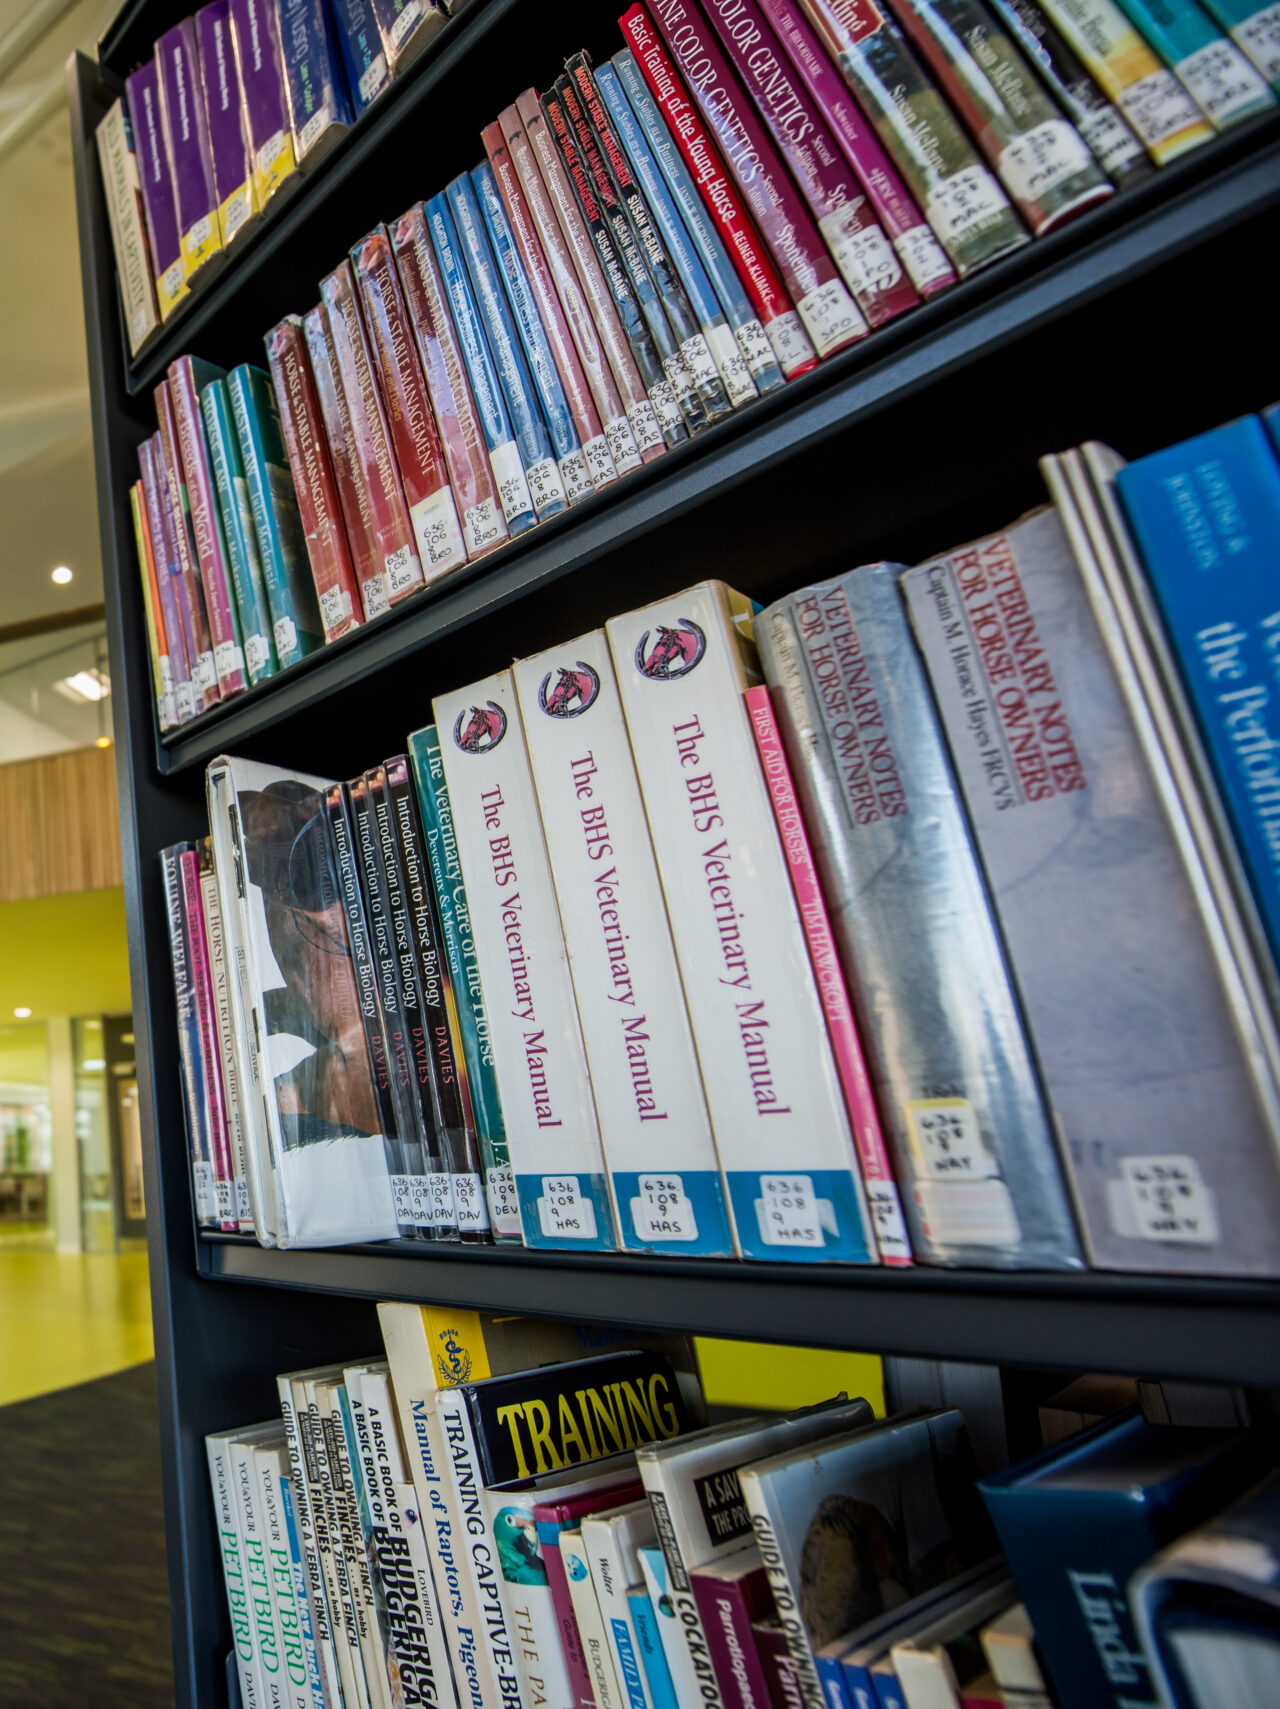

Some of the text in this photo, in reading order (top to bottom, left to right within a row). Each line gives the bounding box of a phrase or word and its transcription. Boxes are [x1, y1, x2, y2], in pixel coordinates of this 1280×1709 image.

[627, 13, 737, 223] Basic Training of the Young Horse
[673, 24, 765, 185] COLOR GENETICS
[748, 46, 814, 143] GENETICS
[562, 85, 648, 284] MODERN STABLE MANAGEMENT SUSAN McBANE
[575, 64, 664, 266] MODERN STABLE MANAGEMENT SUSAN McBANE
[548, 101, 629, 298] MODERN STABLE MANAGEMENT SUSAN McBANE
[731, 230, 776, 305] REINER KLIMKE
[379, 266, 437, 475] HORSE STABLE MANAGEMENT
[440, 347, 480, 452] MANAGEMENT
[242, 436, 258, 478] LAW
[344, 429, 372, 529] MANAGEMENT
[365, 399, 398, 502] MANAGEMENT
[304, 451, 332, 547] MANAGEMENT
[505, 501, 527, 519] BRO
[535, 488, 560, 508] BRO
[568, 478, 594, 499] BRO
[197, 504, 214, 561] World
[259, 525, 276, 591] Mackenzie
[430, 546, 453, 565] BRO
[473, 526, 498, 546] BRO
[229, 540, 244, 605] Mackenzie
[392, 573, 412, 591] BRO
[952, 546, 1056, 803] FOR HORSE OWNERS
[981, 536, 1088, 794] VETERINARY NOTES
[1196, 621, 1247, 678] the
[795, 593, 882, 826] FOR HORSE OWNERS
[821, 583, 910, 819] VETERINARY NOTES
[965, 697, 993, 748] Hayes
[753, 707, 808, 866] FIRST AID HORSES
[333, 818, 377, 1019] Introduction Horse Biology
[357, 810, 398, 1015] Introduction Horse Biology
[376, 801, 418, 1011] Introduction Horse Biology
[397, 795, 441, 1009] Introduction Horse Biology
[426, 828, 459, 975] Devereux Morrison
[427, 744, 496, 1069] The Veterinary Care Horse
[672, 714, 792, 1117] The BHS Veterinary Manual
[480, 783, 563, 1130] The BHS Veterinary Manual
[570, 750, 669, 1124] The BHS Veterinary Manual
[173, 927, 192, 1019] WELFARE
[216, 970, 233, 1064] NUTRITION
[371, 1035, 390, 1091] DAVIES
[391, 1031, 411, 1088] DAVIES
[412, 1027, 431, 1085] DAVIES
[435, 1026, 456, 1085] DAVIES
[412, 1210, 434, 1222] DAV
[434, 1208, 454, 1220] DAV
[458, 1210, 481, 1223] DAV
[494, 1204, 519, 1217] DEV
[548, 1181, 575, 1194] 636
[649, 1192, 679, 1205] 108
[766, 1180, 805, 1195] 636
[556, 1218, 582, 1231] HAS
[650, 1220, 683, 1234] HAS
[777, 1227, 818, 1241] HAS
[281, 1400, 297, 1443] GUIDE
[308, 1403, 324, 1446] GUIDE
[331, 1409, 348, 1455] GUIDE
[409, 1398, 440, 1482] Manual
[496, 1372, 680, 1479] TRAINING
[289, 1445, 300, 1464] TO
[315, 1448, 327, 1468] TO
[339, 1458, 351, 1478] TO
[354, 1411, 386, 1522] BASIC BOOK OF
[371, 1418, 402, 1533] BASIC BOOK OF
[444, 1409, 485, 1536] TRAINING
[293, 1467, 312, 1528] OWNING
[320, 1471, 340, 1533] OWNING
[344, 1479, 364, 1543] OWNING
[429, 1488, 446, 1516] of
[712, 1510, 735, 1535] THE
[305, 1545, 322, 1592] ZEBRA
[309, 1488, 331, 1555] FINCHES
[329, 1597, 341, 1629] hobby
[334, 1496, 357, 1563] FINCHES
[356, 1606, 369, 1641] hobby
[334, 1550, 350, 1598] ZEBRA
[357, 1559, 374, 1607] FINCH
[433, 1518, 464, 1617] Raptors,
[599, 1556, 615, 1597] Wolter
[753, 1514, 795, 1612] GUIDE TO
[314, 1595, 330, 1642] FINCH
[343, 1601, 359, 1649] FINCH
[417, 1568, 434, 1626] LOVEBIRD
[514, 1605, 540, 1663] THE
[637, 1614, 654, 1656] Vriends
